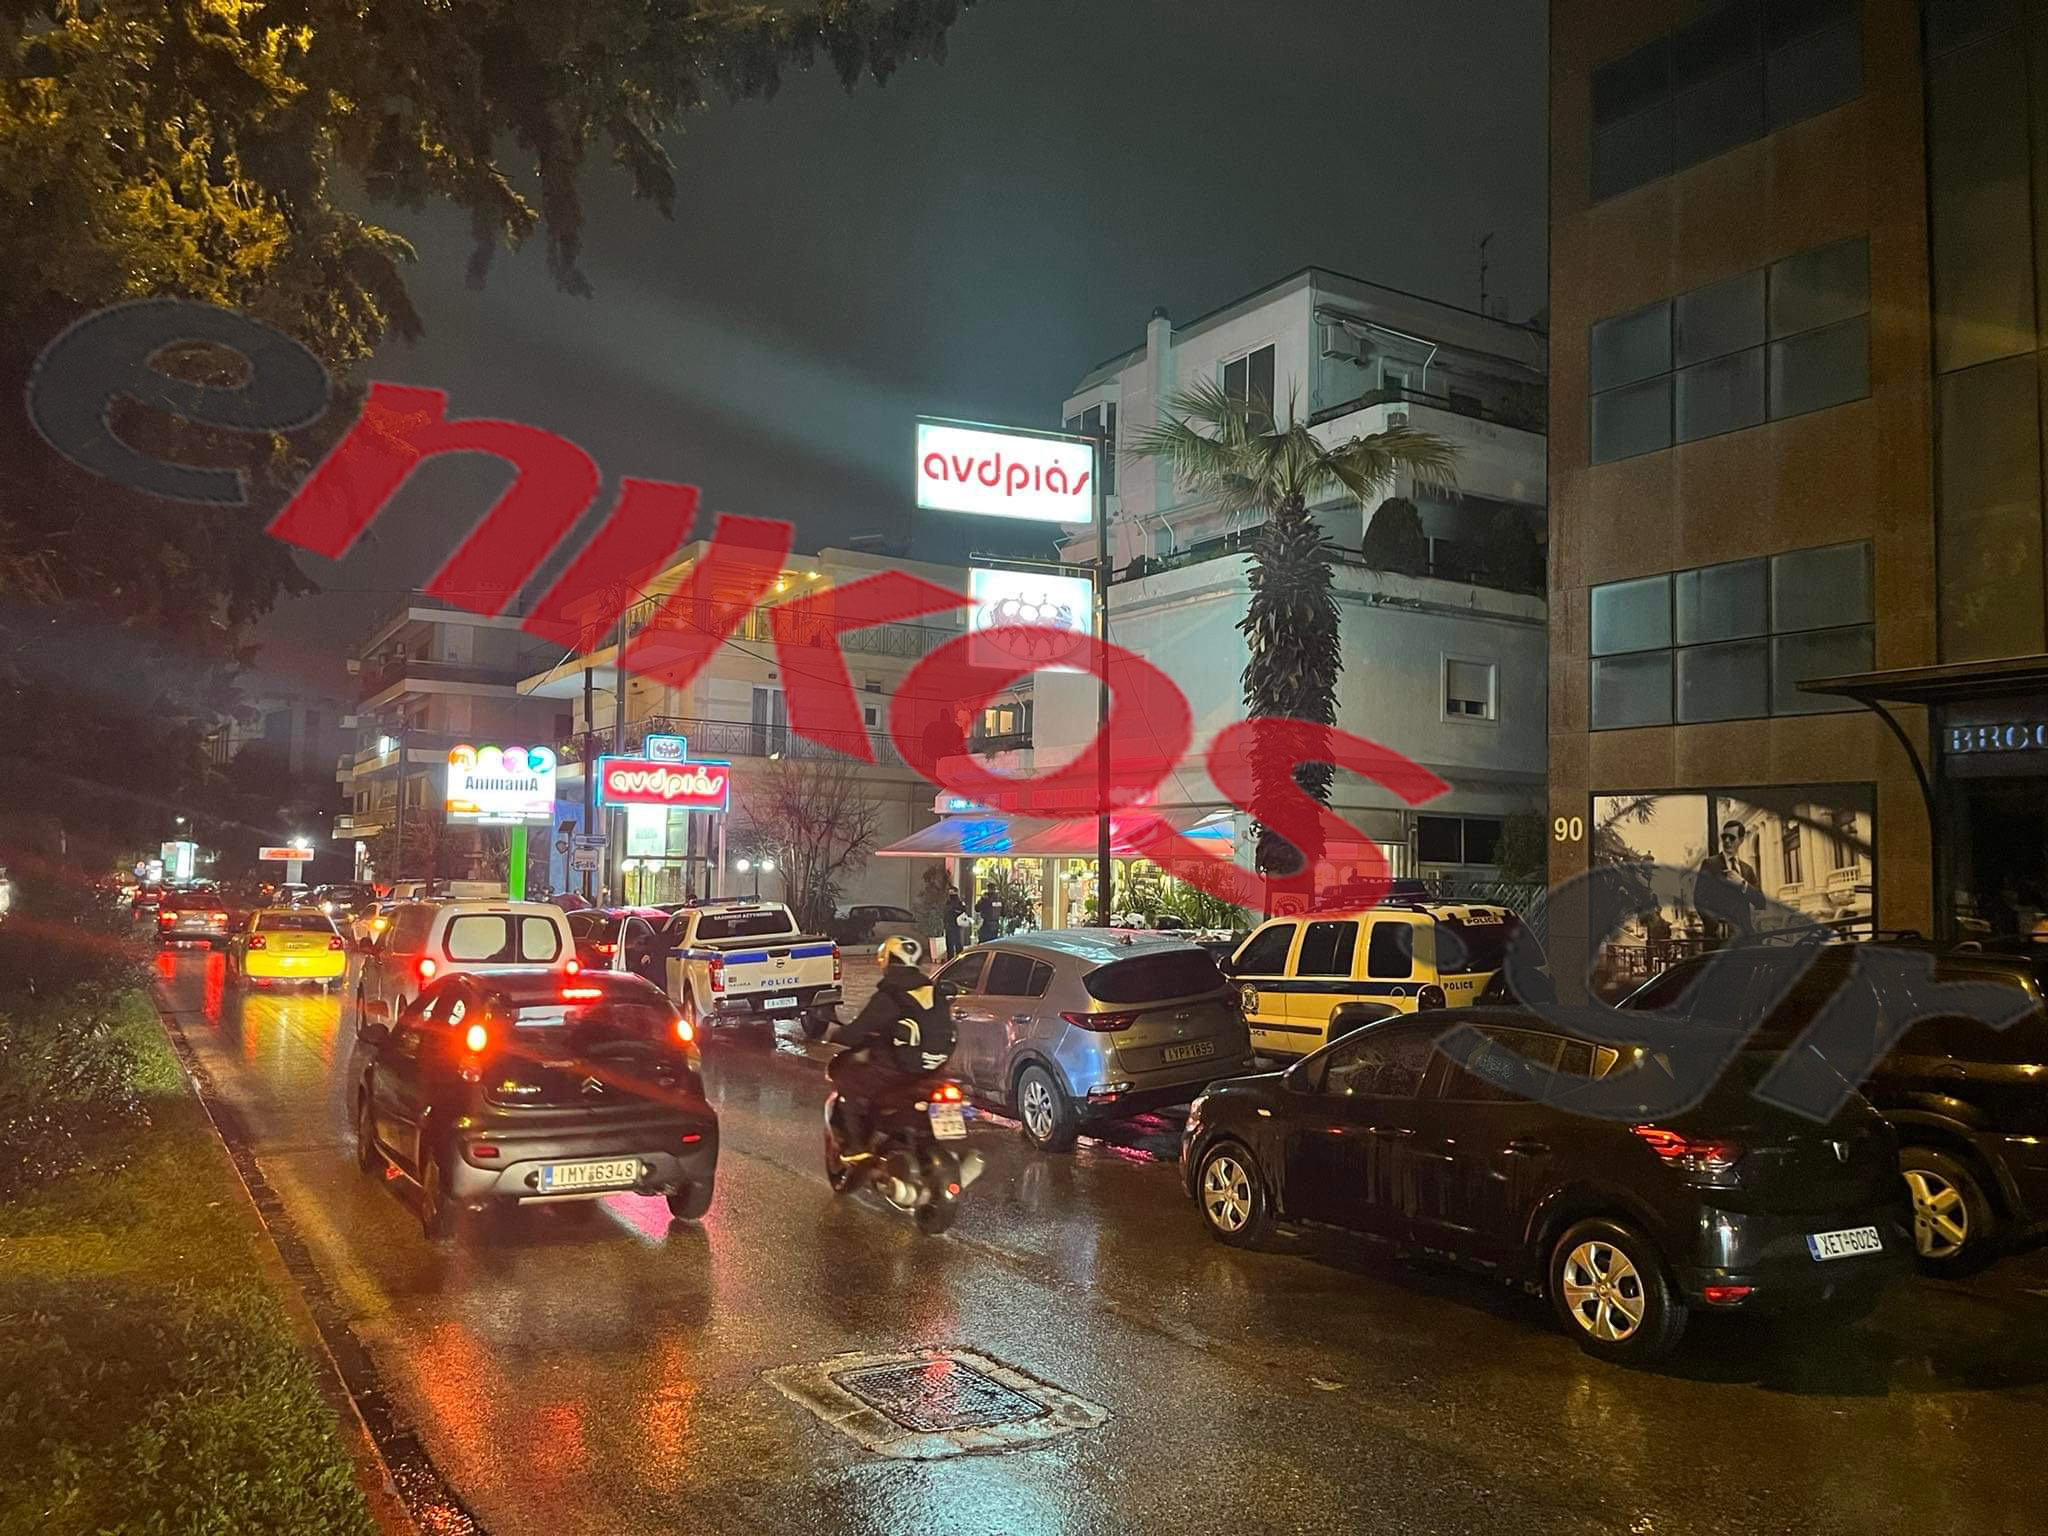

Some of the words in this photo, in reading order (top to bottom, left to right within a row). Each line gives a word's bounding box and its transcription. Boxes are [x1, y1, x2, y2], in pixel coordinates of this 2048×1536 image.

[1554, 816, 1583, 842] 90
[742, 911, 774, 919] ΑΣΤΥΝΑ
[1465, 916, 1502, 925] POLICE
[760, 976, 801, 988] POLICE
[1443, 981, 1474, 991] POLICE
